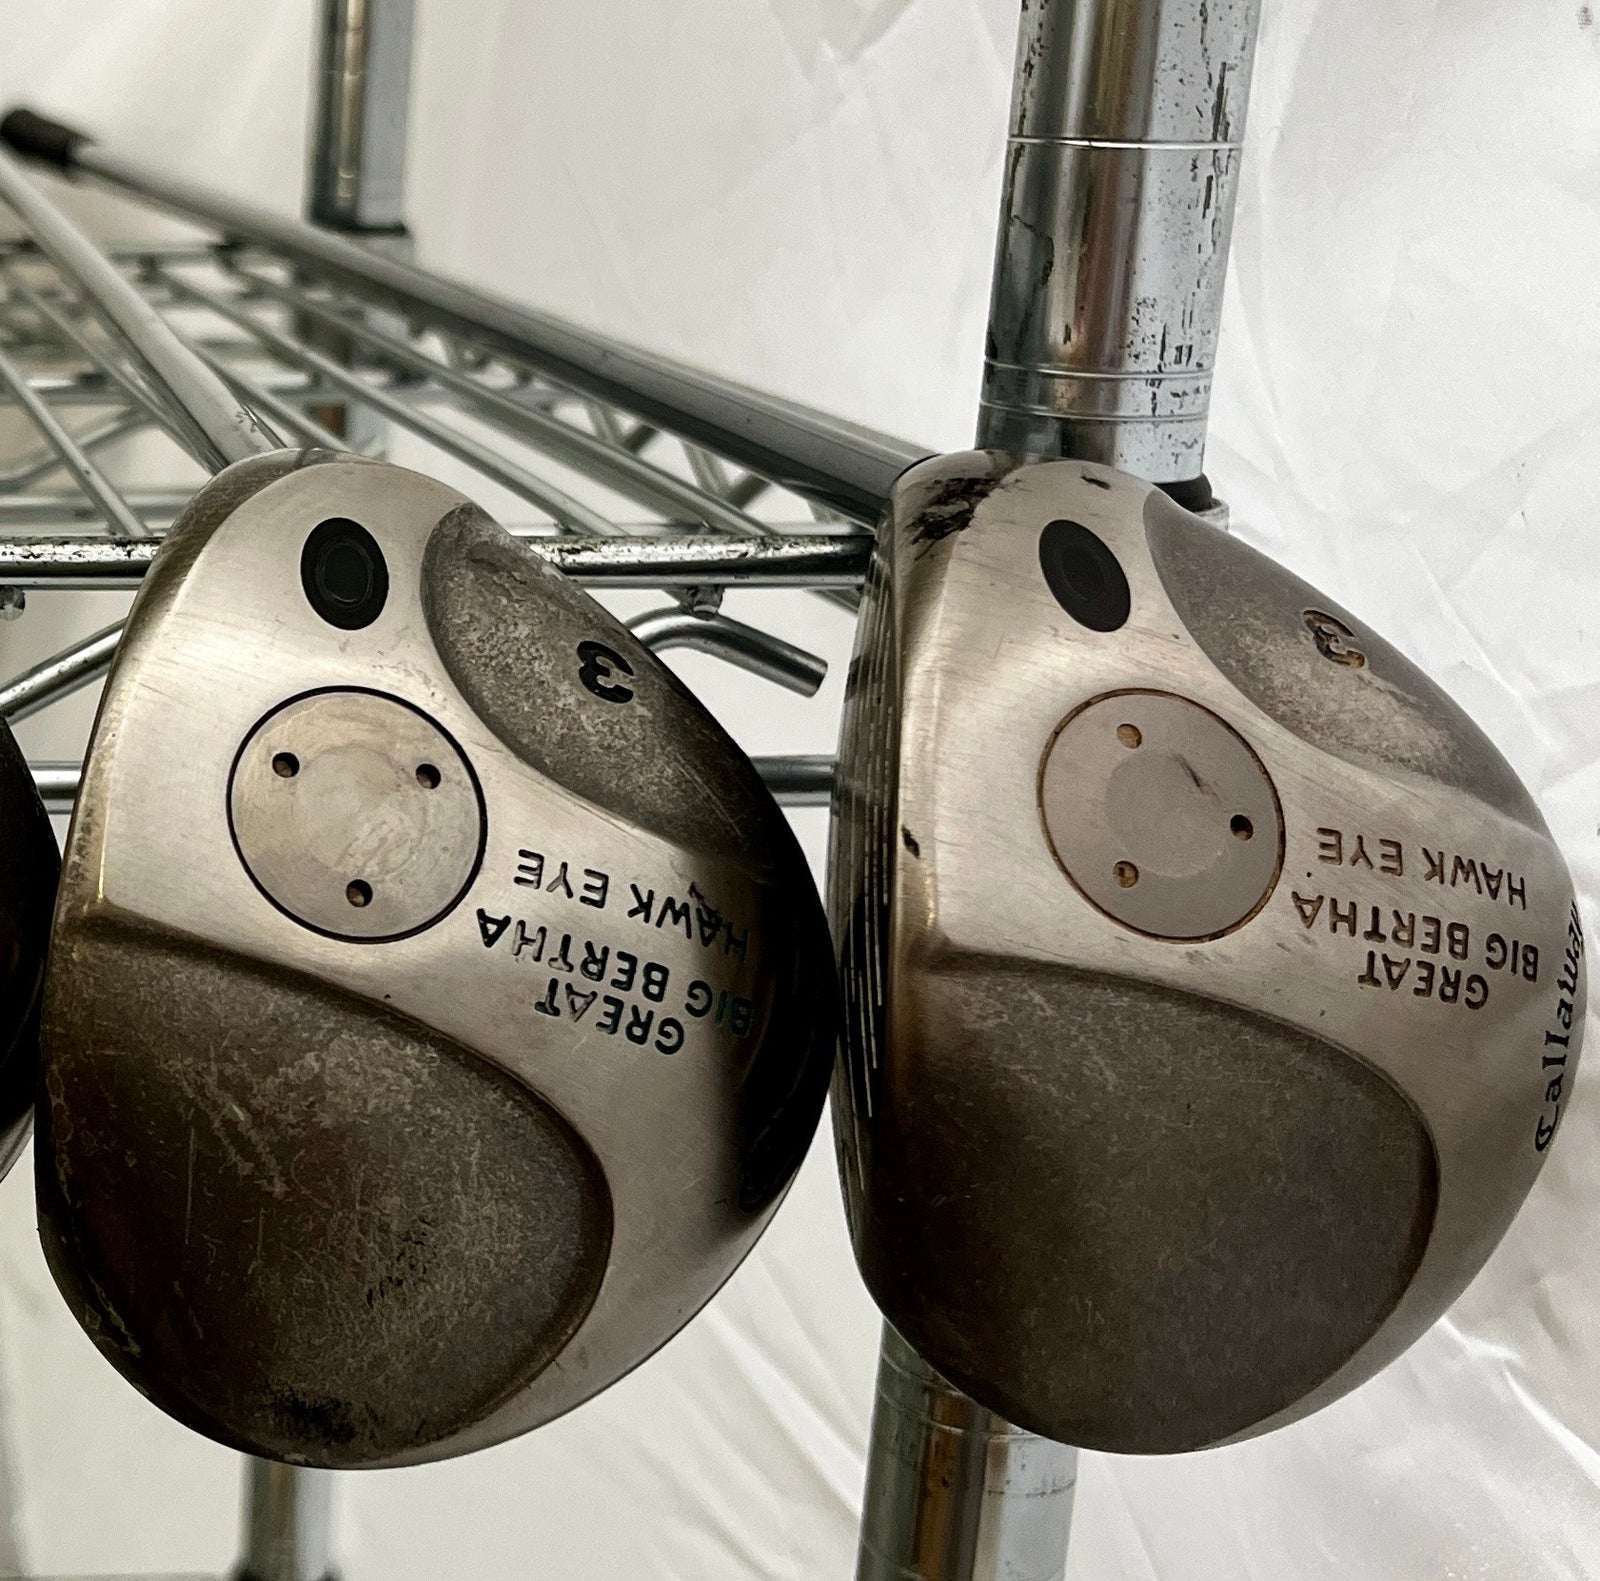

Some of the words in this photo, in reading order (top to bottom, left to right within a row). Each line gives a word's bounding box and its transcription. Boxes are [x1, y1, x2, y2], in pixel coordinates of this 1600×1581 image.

[1303, 609, 1365, 668] 3
[577, 640, 634, 704] 3
[513, 849, 609, 909] EYE
[1316, 827, 1404, 877] EYE
[1421, 847, 1527, 911] HAWK
[627, 884, 749, 962] HAWK
[1291, 890, 1470, 961] BERTHA
[476, 908, 670, 1003] BERTHA
[1357, 950, 1489, 1010] GREAT
[1485, 933, 1539, 983] BIG
[534, 977, 685, 1055] GREAT
[685, 979, 752, 1038] BIG
